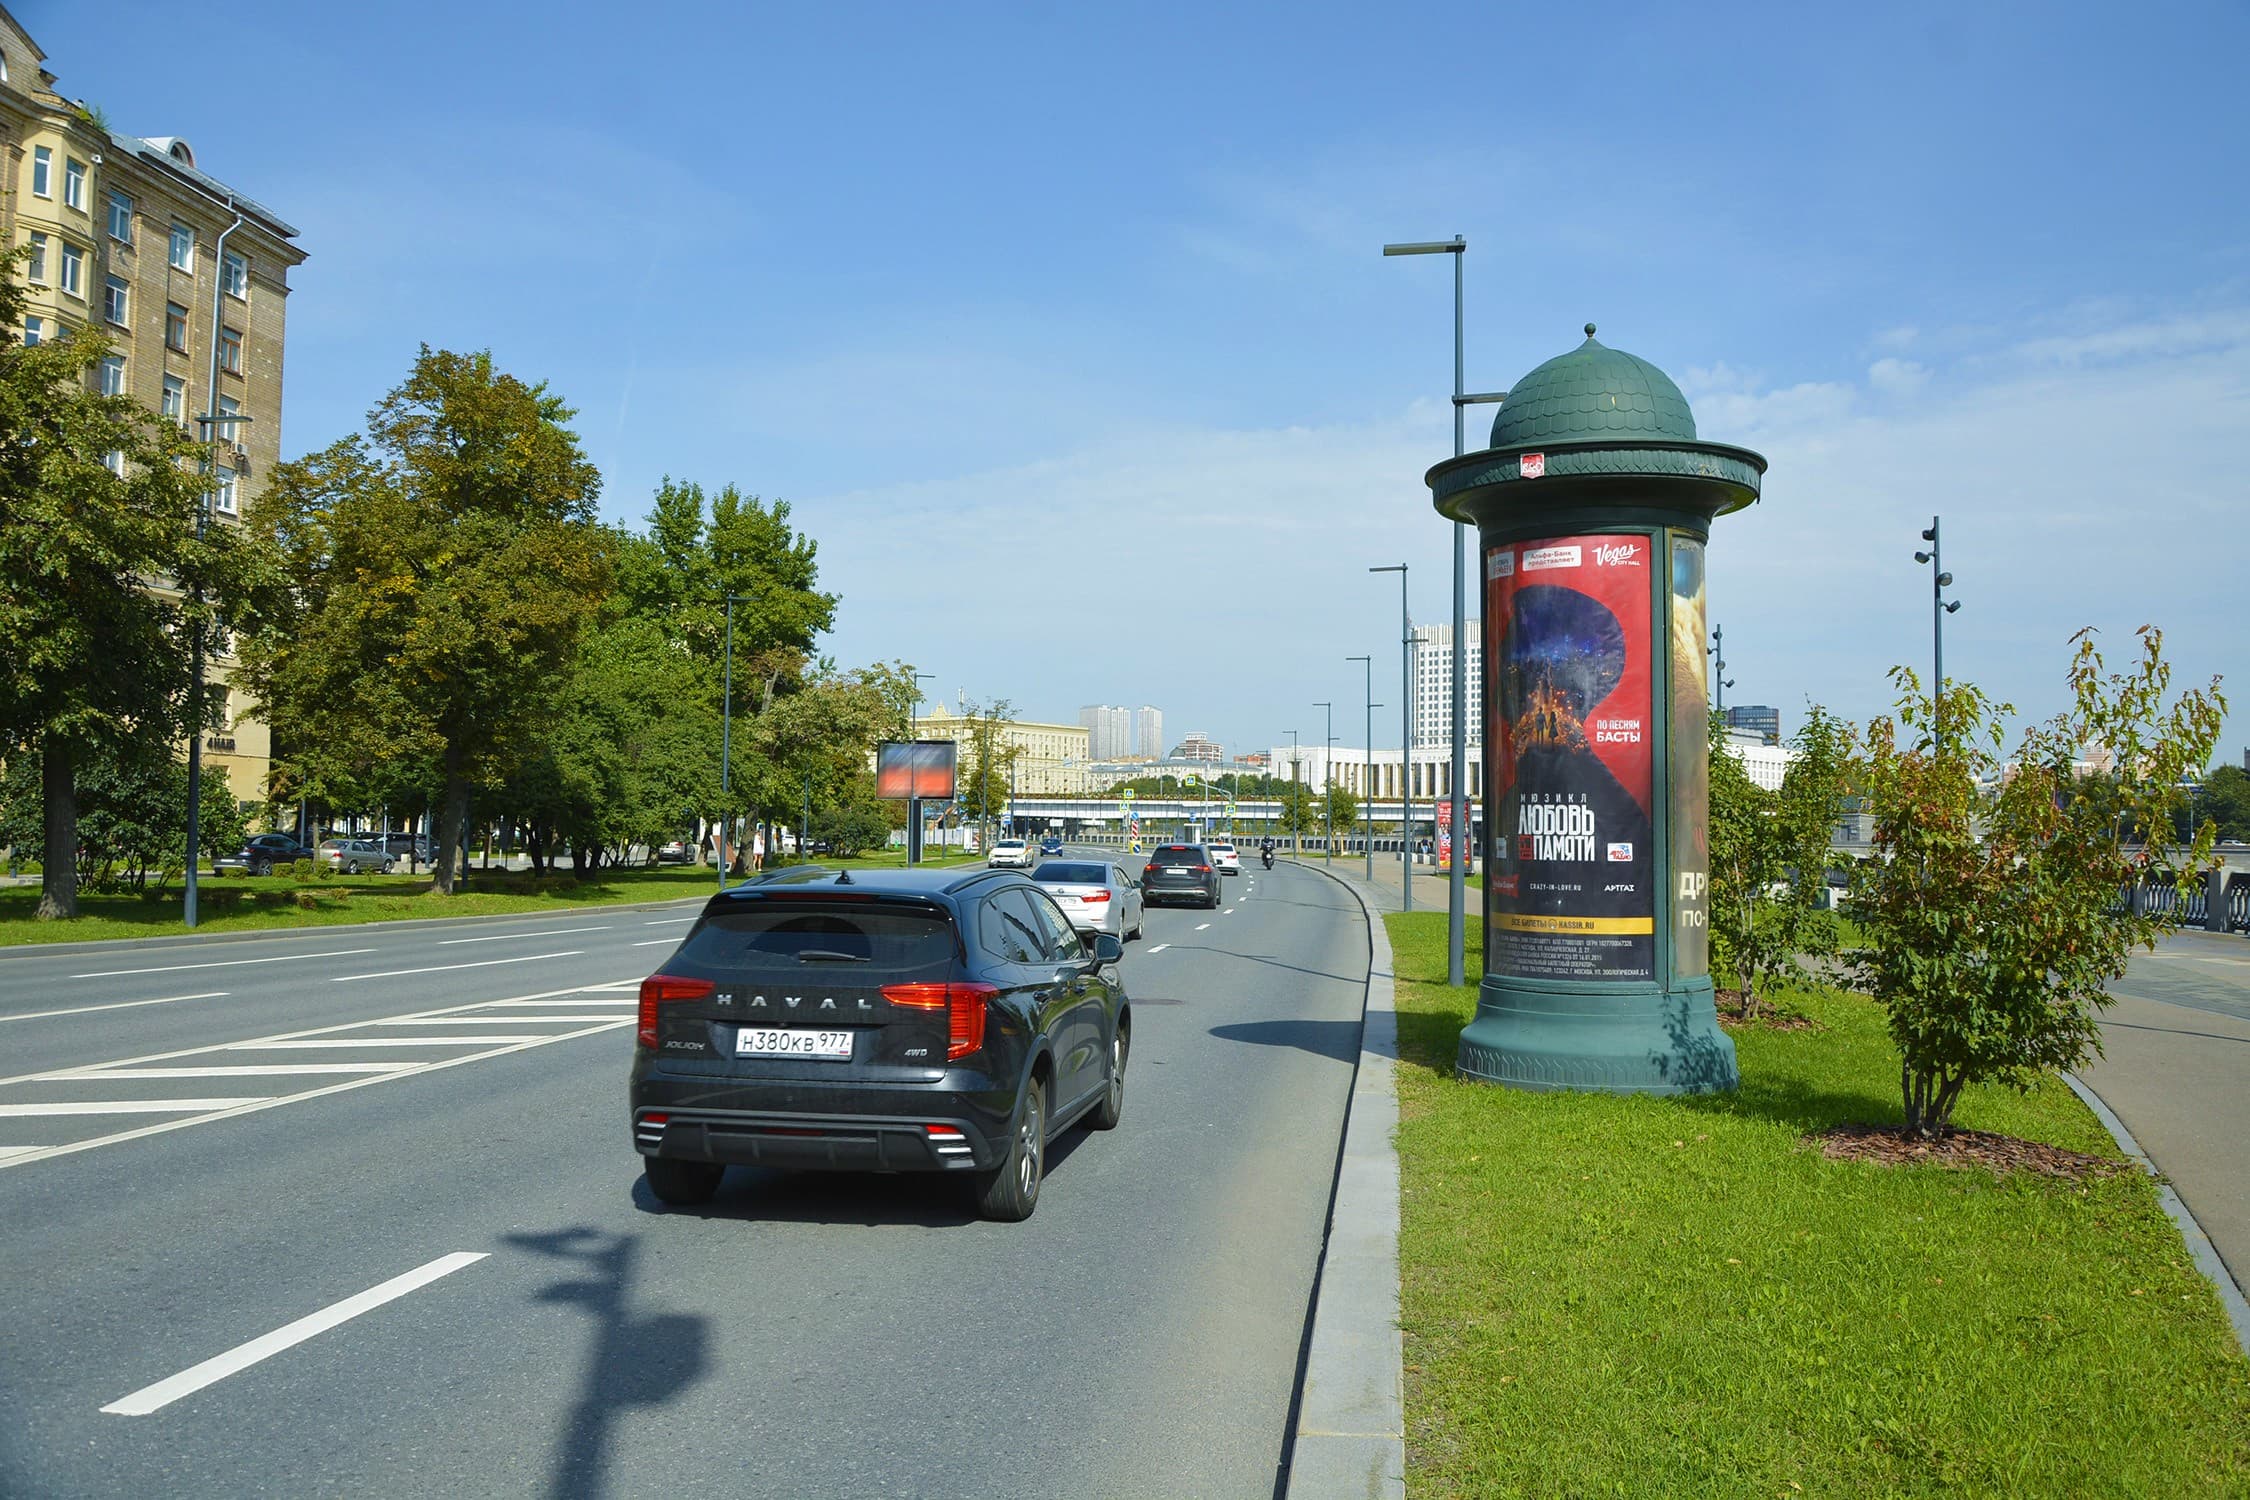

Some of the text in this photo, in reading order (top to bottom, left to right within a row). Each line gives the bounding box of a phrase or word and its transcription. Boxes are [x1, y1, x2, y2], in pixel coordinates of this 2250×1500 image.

[1591, 543, 1641, 566] Vegas
[1596, 719, 1640, 730] ПО ПЕСНЯМ
[1596, 731, 1641, 743] БАСТЫ
[1518, 804, 1595, 836] ЛЮБОВЬ
[1533, 835, 1595, 862] ПАМЯТИ
[1679, 872, 1709, 901] ДР
[1521, 918, 1547, 928] БИЛЕТЫ
[1558, 920, 1595, 929] KASSIR.RU
[717, 994, 873, 1010] HAVAL
[742, 1032, 847, 1052] Н380КВ 977
[903, 1048, 928, 1057] 4WD
